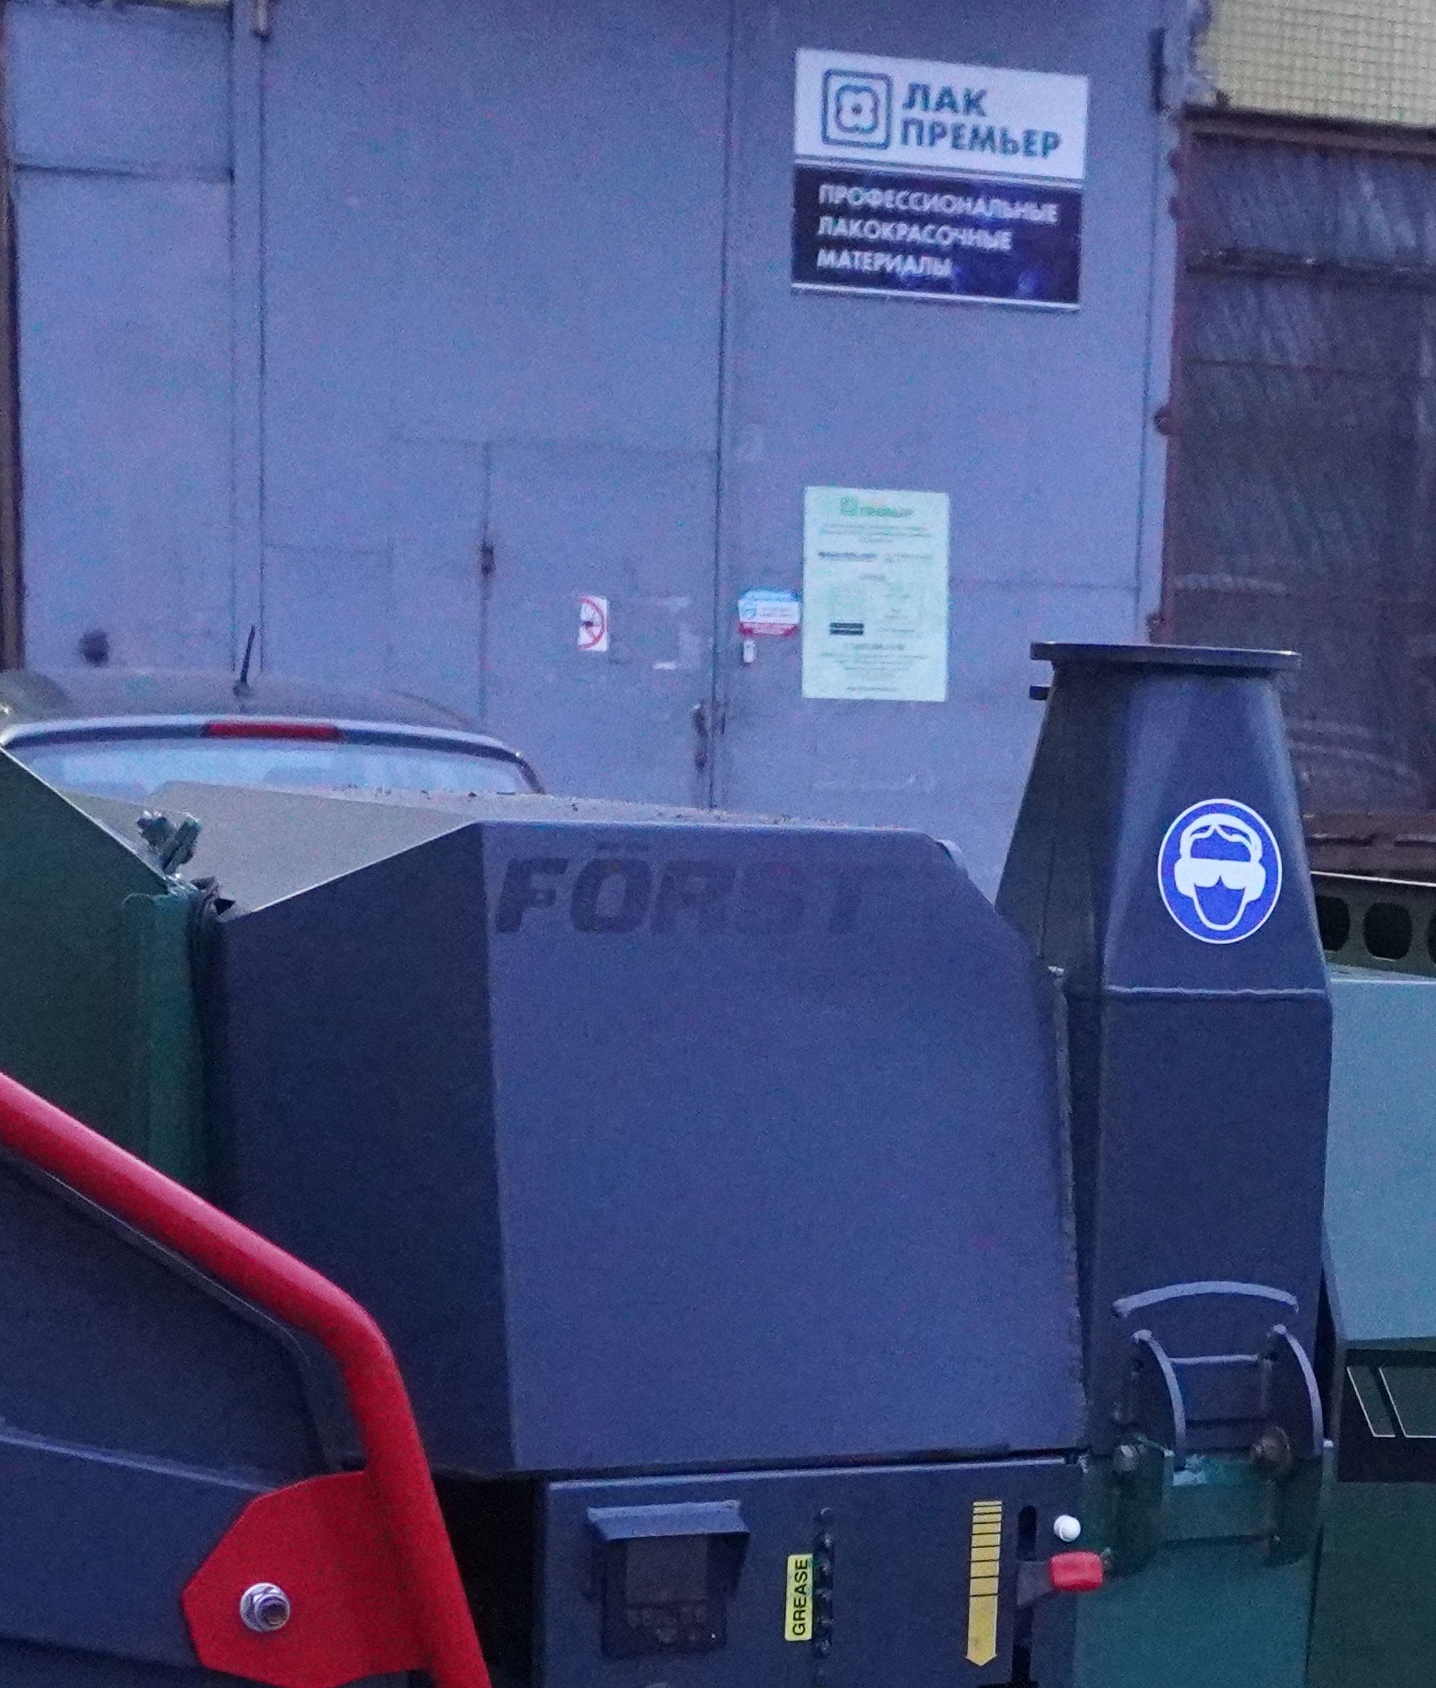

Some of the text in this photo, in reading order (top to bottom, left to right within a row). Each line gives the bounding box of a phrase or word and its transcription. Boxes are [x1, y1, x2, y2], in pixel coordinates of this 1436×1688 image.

[902, 82, 986, 116] ЛАК
[901, 117, 1061, 158] ПРЕМЬЕР
[818, 184, 1058, 222] ПРОФЕССИОНАЛЬНЫЕ
[818, 216, 1012, 250] ЛАКОКРАСОЧНЫЕ
[817, 249, 953, 277] МАТЕРИАЛЫ
[792, 1560, 807, 1636] GREASE
